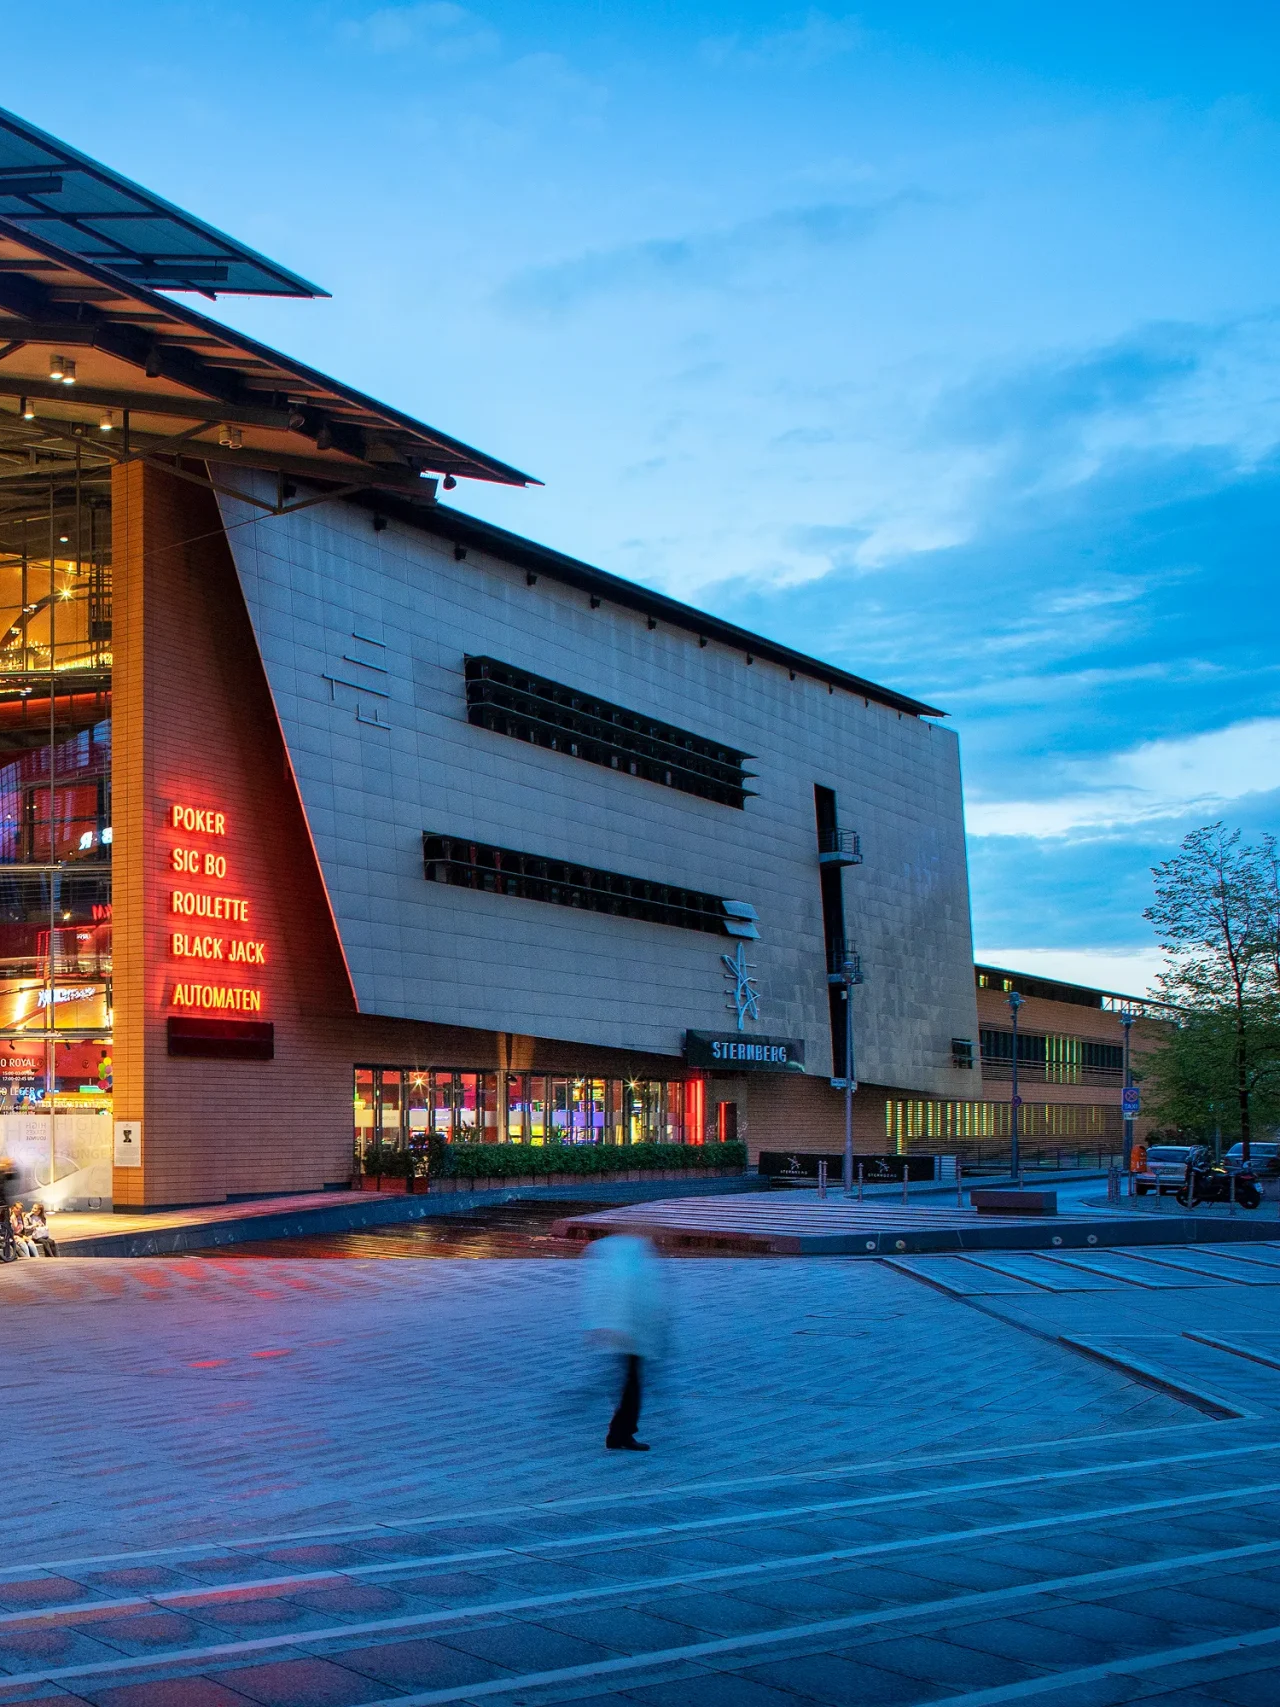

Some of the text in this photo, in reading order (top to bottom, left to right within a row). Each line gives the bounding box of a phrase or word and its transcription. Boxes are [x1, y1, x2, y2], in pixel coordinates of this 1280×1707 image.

[171, 805, 225, 836] POKER
[171, 847, 227, 879] SIC BO
[171, 890, 249, 922] ROULETTE
[171, 933, 265, 965] BLACK JACK
[172, 983, 261, 1012] AUTOMATEN
[9, 1058, 36, 1068] ROYAL
[712, 1041, 787, 1063] STERNBERG
[56, 1117, 101, 1131] HIGH
